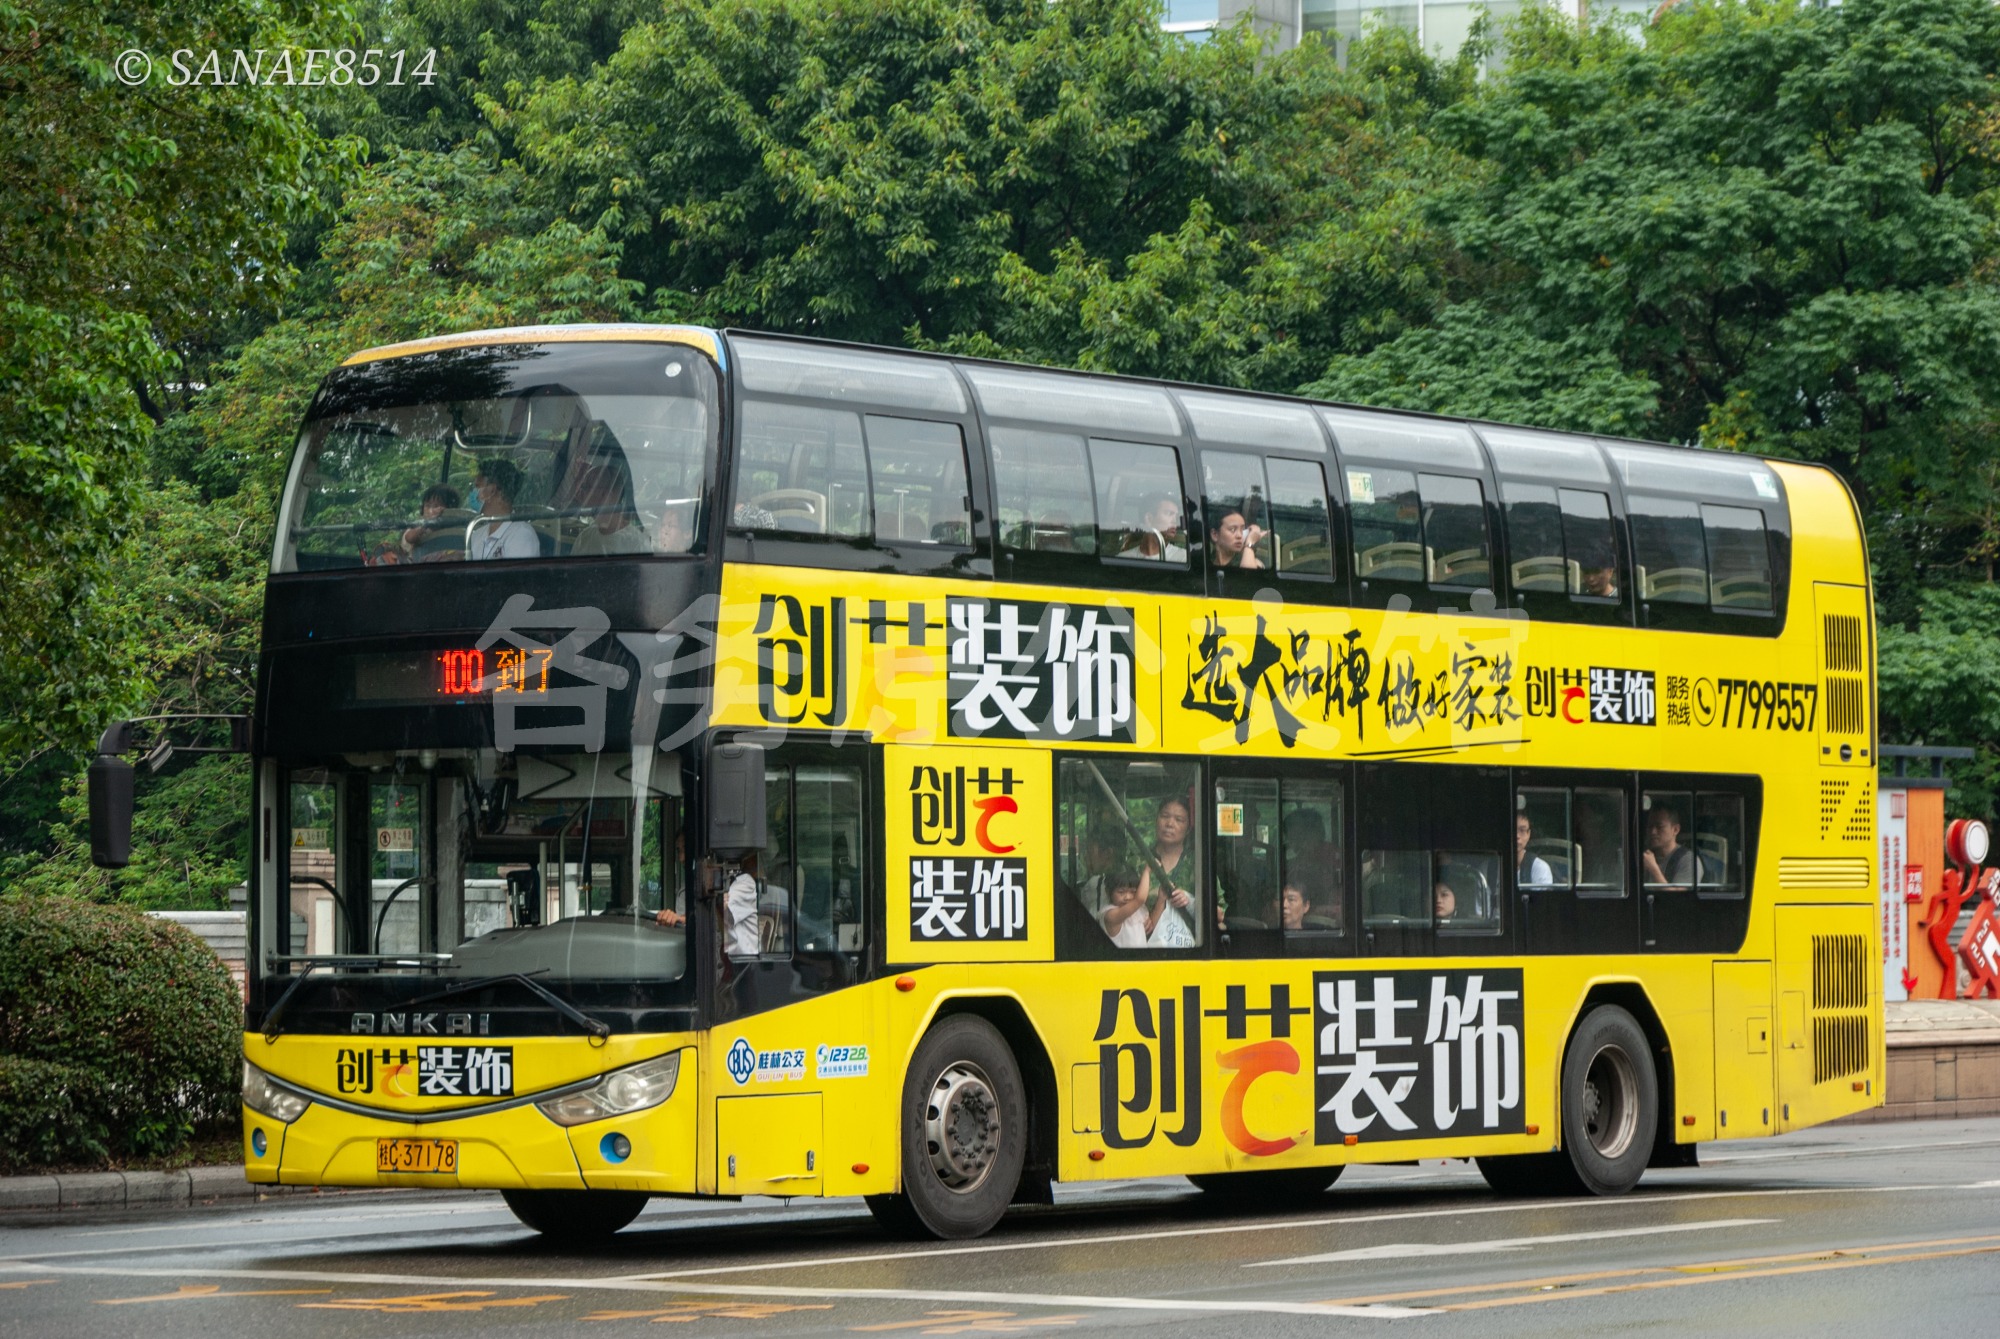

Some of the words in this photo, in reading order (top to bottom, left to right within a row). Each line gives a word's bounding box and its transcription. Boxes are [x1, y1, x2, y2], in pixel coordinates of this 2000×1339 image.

[1525, 665, 1656, 726] 创艺装饰
[1666, 676, 1690, 700] 服务
[1667, 702, 1691, 727] 热线
[1717, 678, 1819, 732] 7799557
[910, 765, 1024, 854] 创艺
[911, 859, 1026, 939] 装饰
[351, 1012, 491, 1035] ANKAI
[758, 1051, 805, 1069] 桂林公交
[1094, 974, 1520, 1157] 创艺装饰
